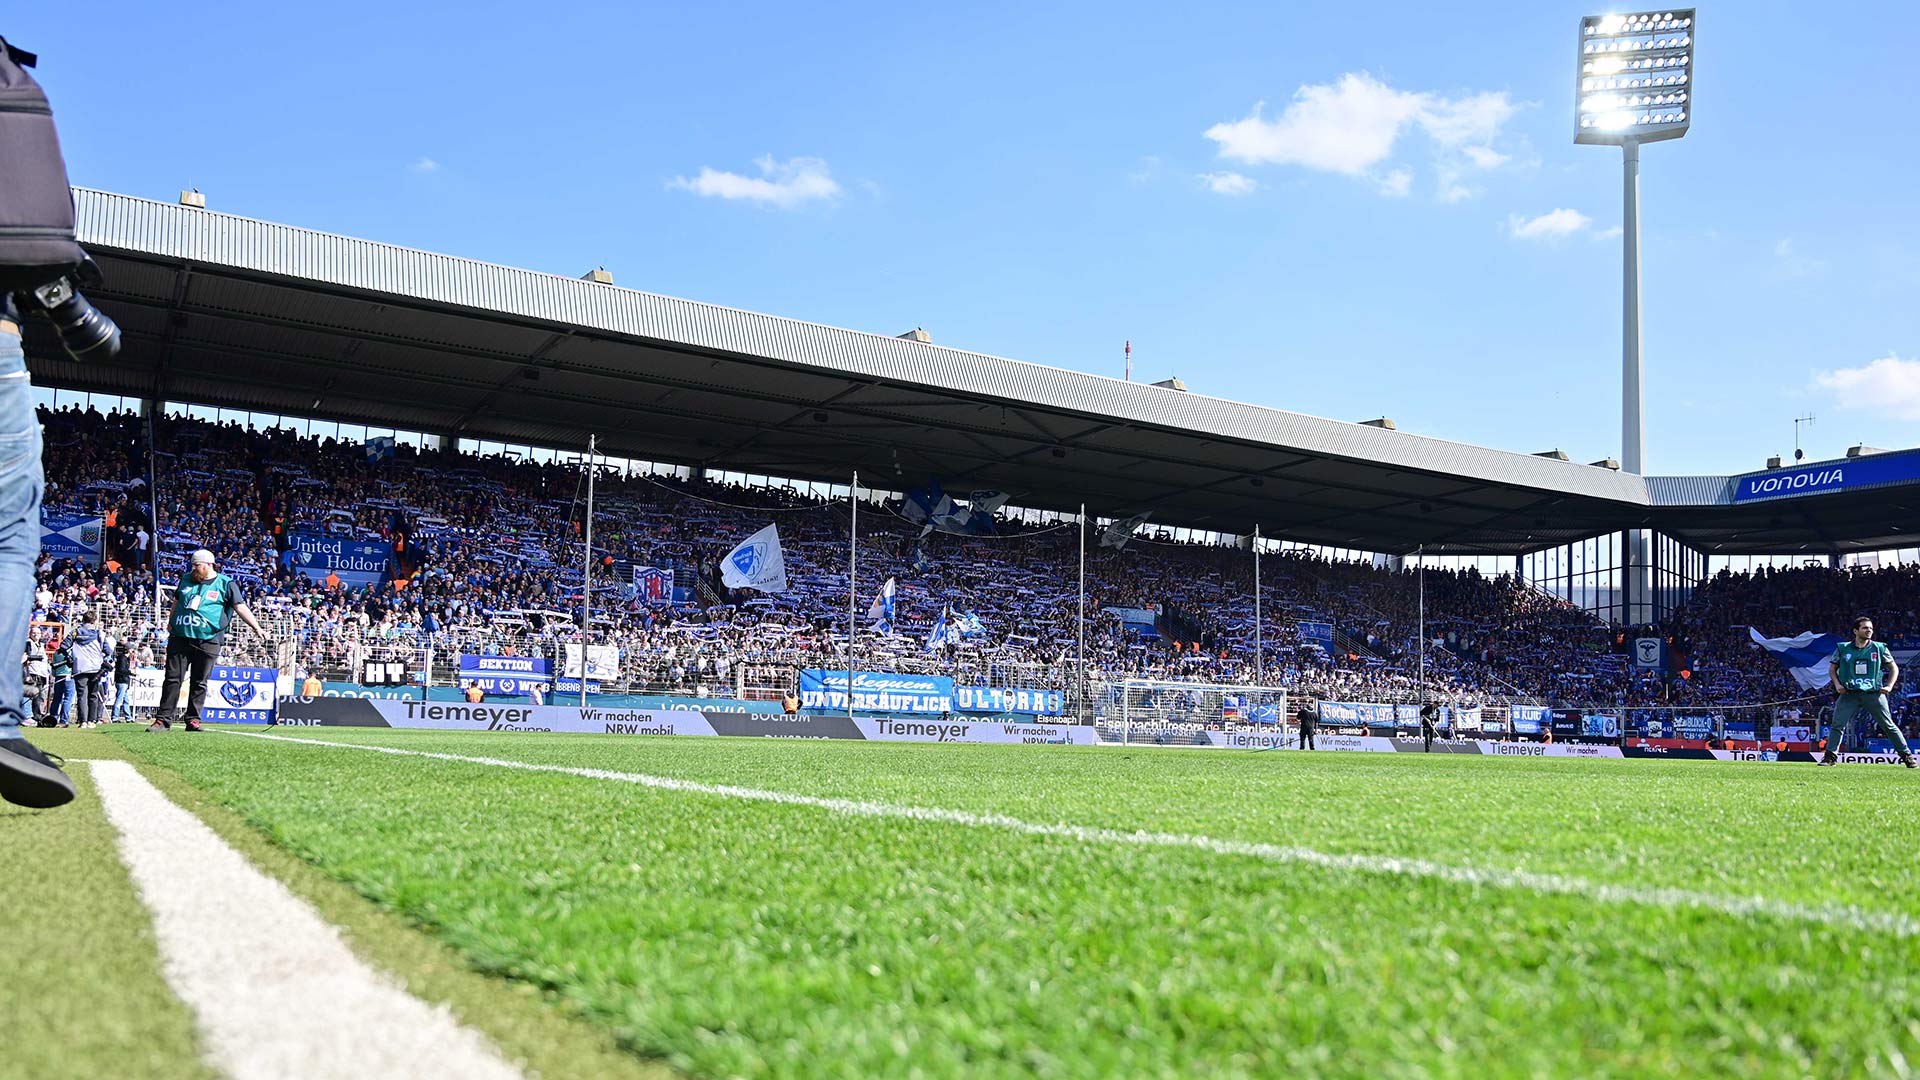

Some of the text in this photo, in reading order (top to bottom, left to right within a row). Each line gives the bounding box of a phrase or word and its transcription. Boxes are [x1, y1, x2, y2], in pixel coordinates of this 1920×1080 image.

[1751, 469, 1843, 494] VONOVIA
[40, 541, 80, 553] hrsturm
[288, 535, 341, 554] United
[327, 554, 389, 571] Holdorf
[176, 615, 208, 628] HOST
[480, 658, 533, 671] SEKTION
[219, 670, 262, 680] BLUE
[823, 674, 935, 691] unbequem
[801, 689, 951, 712] UNVERKÄUFLICH
[206, 710, 267, 720] HEARTS
[402, 701, 532, 730] Tiemeyer
[580, 709, 652, 722] Wir machen
[605, 723, 677, 735] NRW mobil.
[876, 719, 969, 741] Tiemeyer
[1004, 725, 1057, 736] Wir machen
[1320, 738, 1333, 746] Wir
[1490, 742, 1546, 756] Tiemeyer
